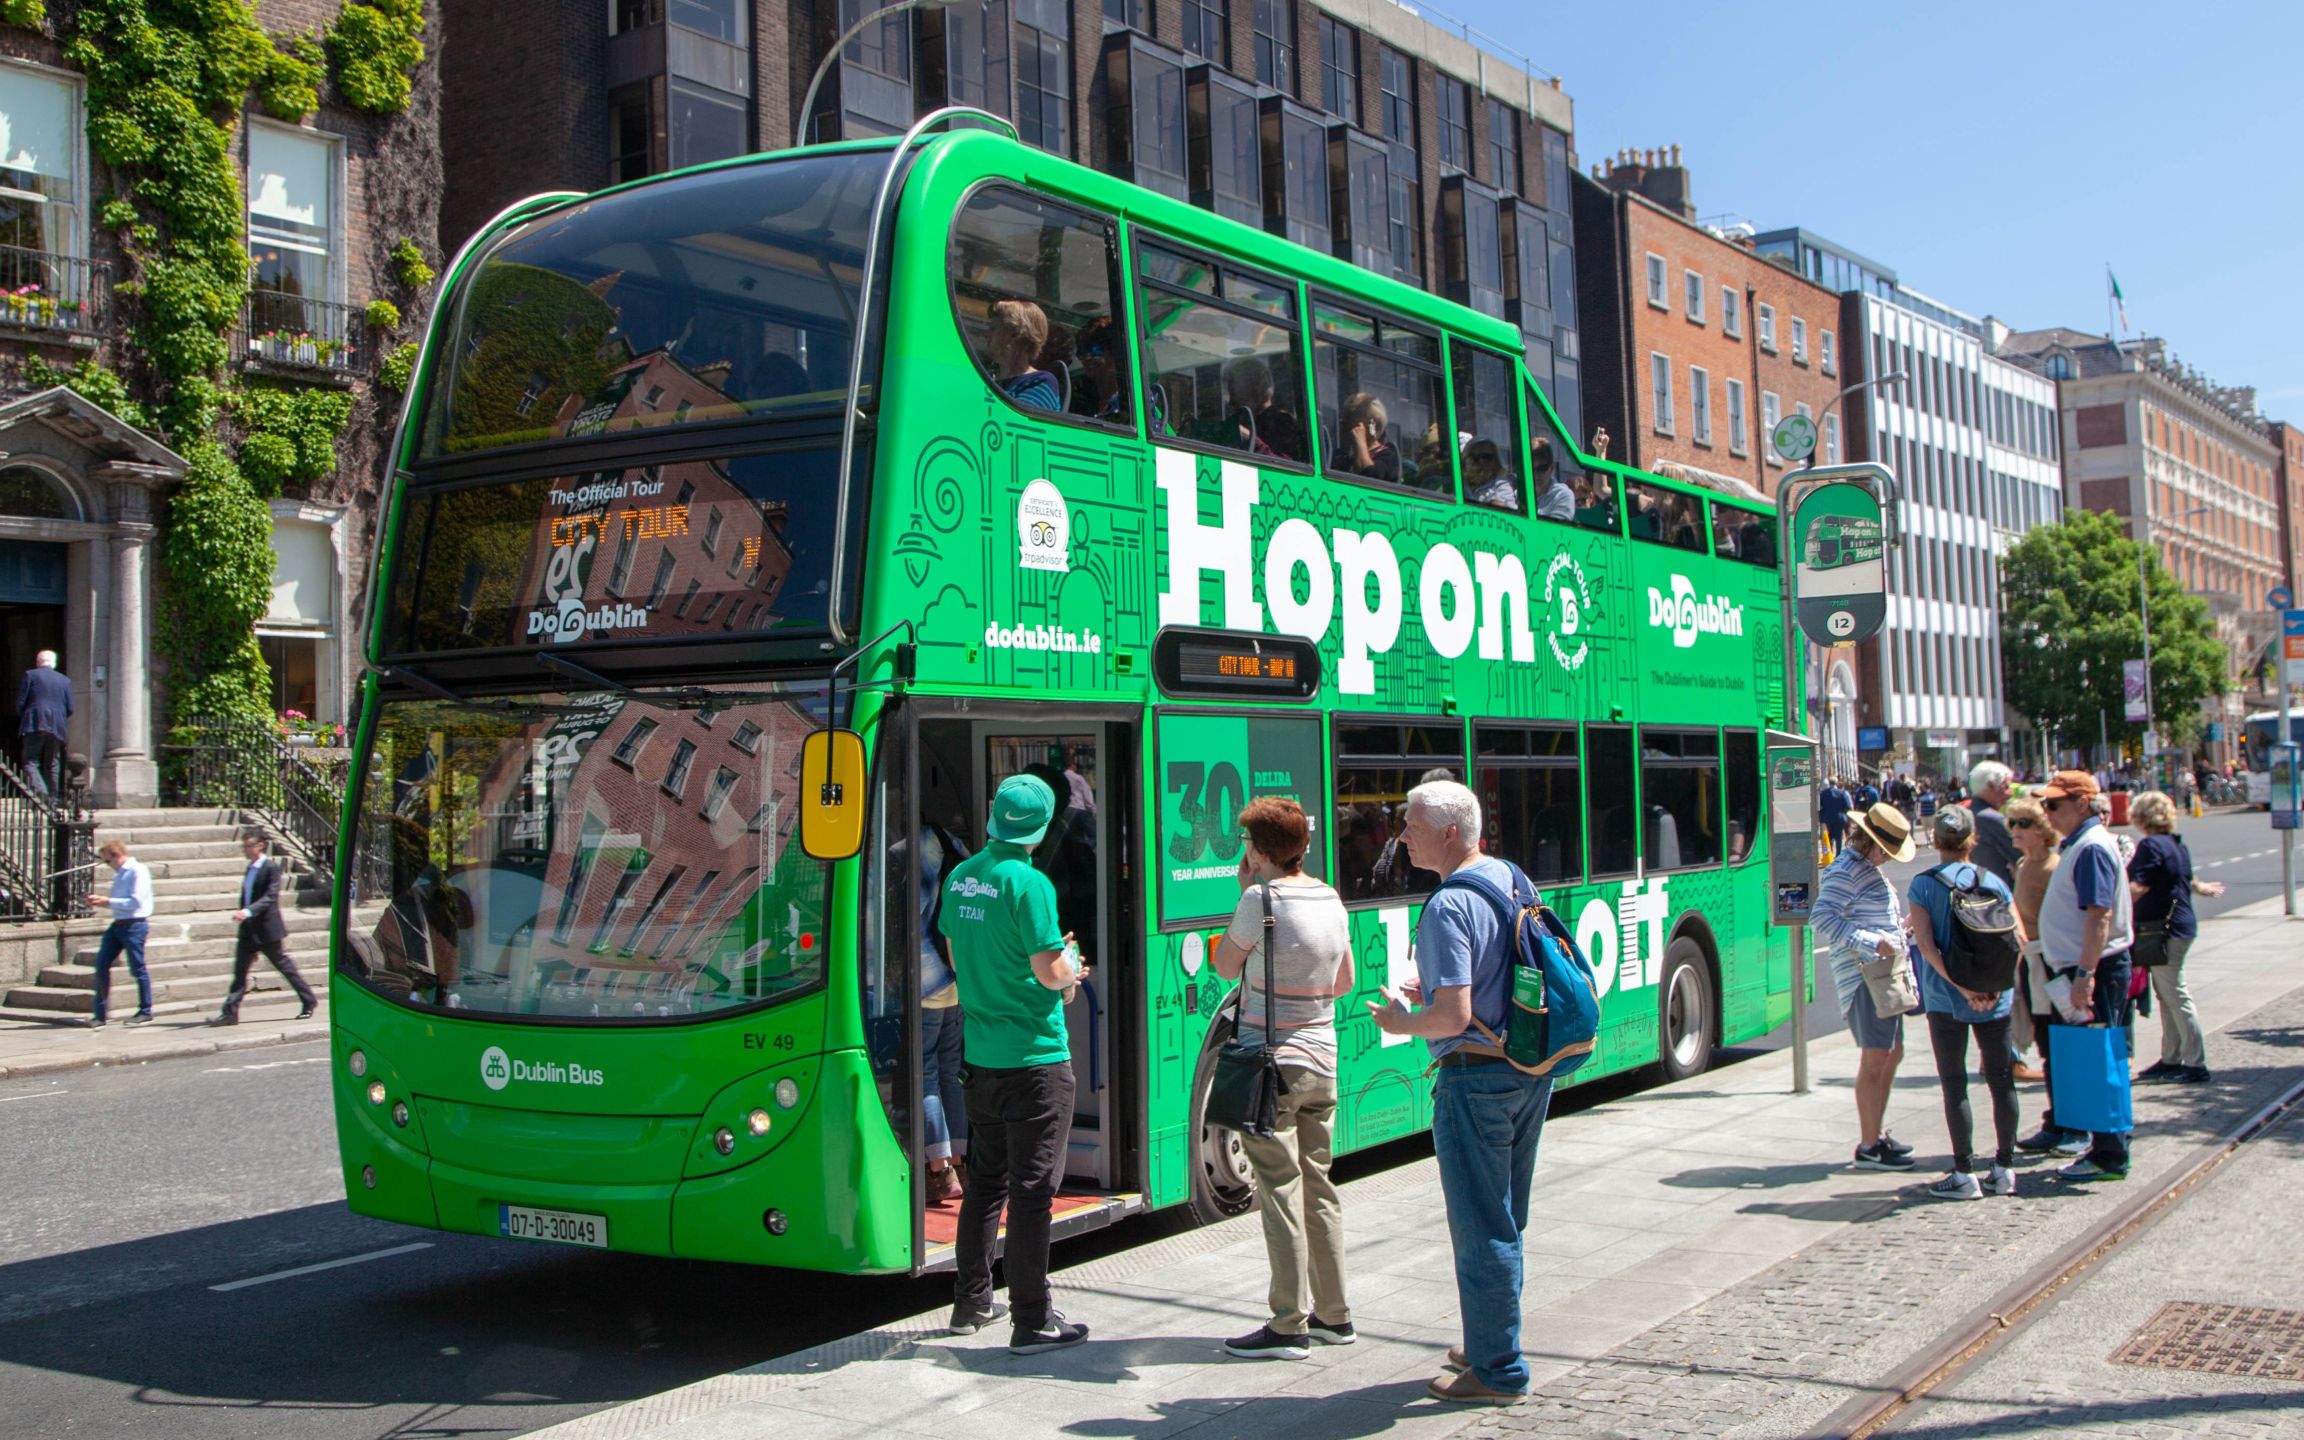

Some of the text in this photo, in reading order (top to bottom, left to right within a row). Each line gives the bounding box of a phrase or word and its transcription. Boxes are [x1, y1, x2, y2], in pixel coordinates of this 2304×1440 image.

[551, 480, 664, 505] The Official Tour
[1025, 505, 1062, 518] EXCELLENCE
[552, 506, 688, 547] CITY TOUR
[1841, 526, 1860, 538] Hop
[1856, 548, 1873, 558] Hop
[1156, 448, 1535, 696] Hop on
[1545, 552, 1590, 609] OFFICIAL TOUR
[527, 600, 653, 643] DoDublin
[1648, 574, 1743, 648] DoDublin
[1835, 618, 1849, 628] 12
[985, 621, 1101, 653] dodublin.ie
[1549, 631, 1571, 671] SINCE
[1219, 656, 1237, 674] CITY
[1239, 656, 1260, 676] TOUR
[1270, 658, 1284, 677] HOP
[1651, 671, 1745, 691] The Dubliner's Guide to Dublin
[1254, 771, 1292, 787] DELIRA
[1168, 761, 1244, 864] 30
[1171, 865, 1240, 881] YEAR ANNIVERSAR
[950, 876, 998, 898] DoDublin
[959, 906, 985, 921] TEAM
[1576, 875, 1669, 998] off
[1156, 993, 1182, 1010] EV 49
[744, 1033, 795, 1050] EV 49
[513, 1059, 604, 1086] Dublin Bus
[511, 1213, 595, 1243] 07-D-30049
